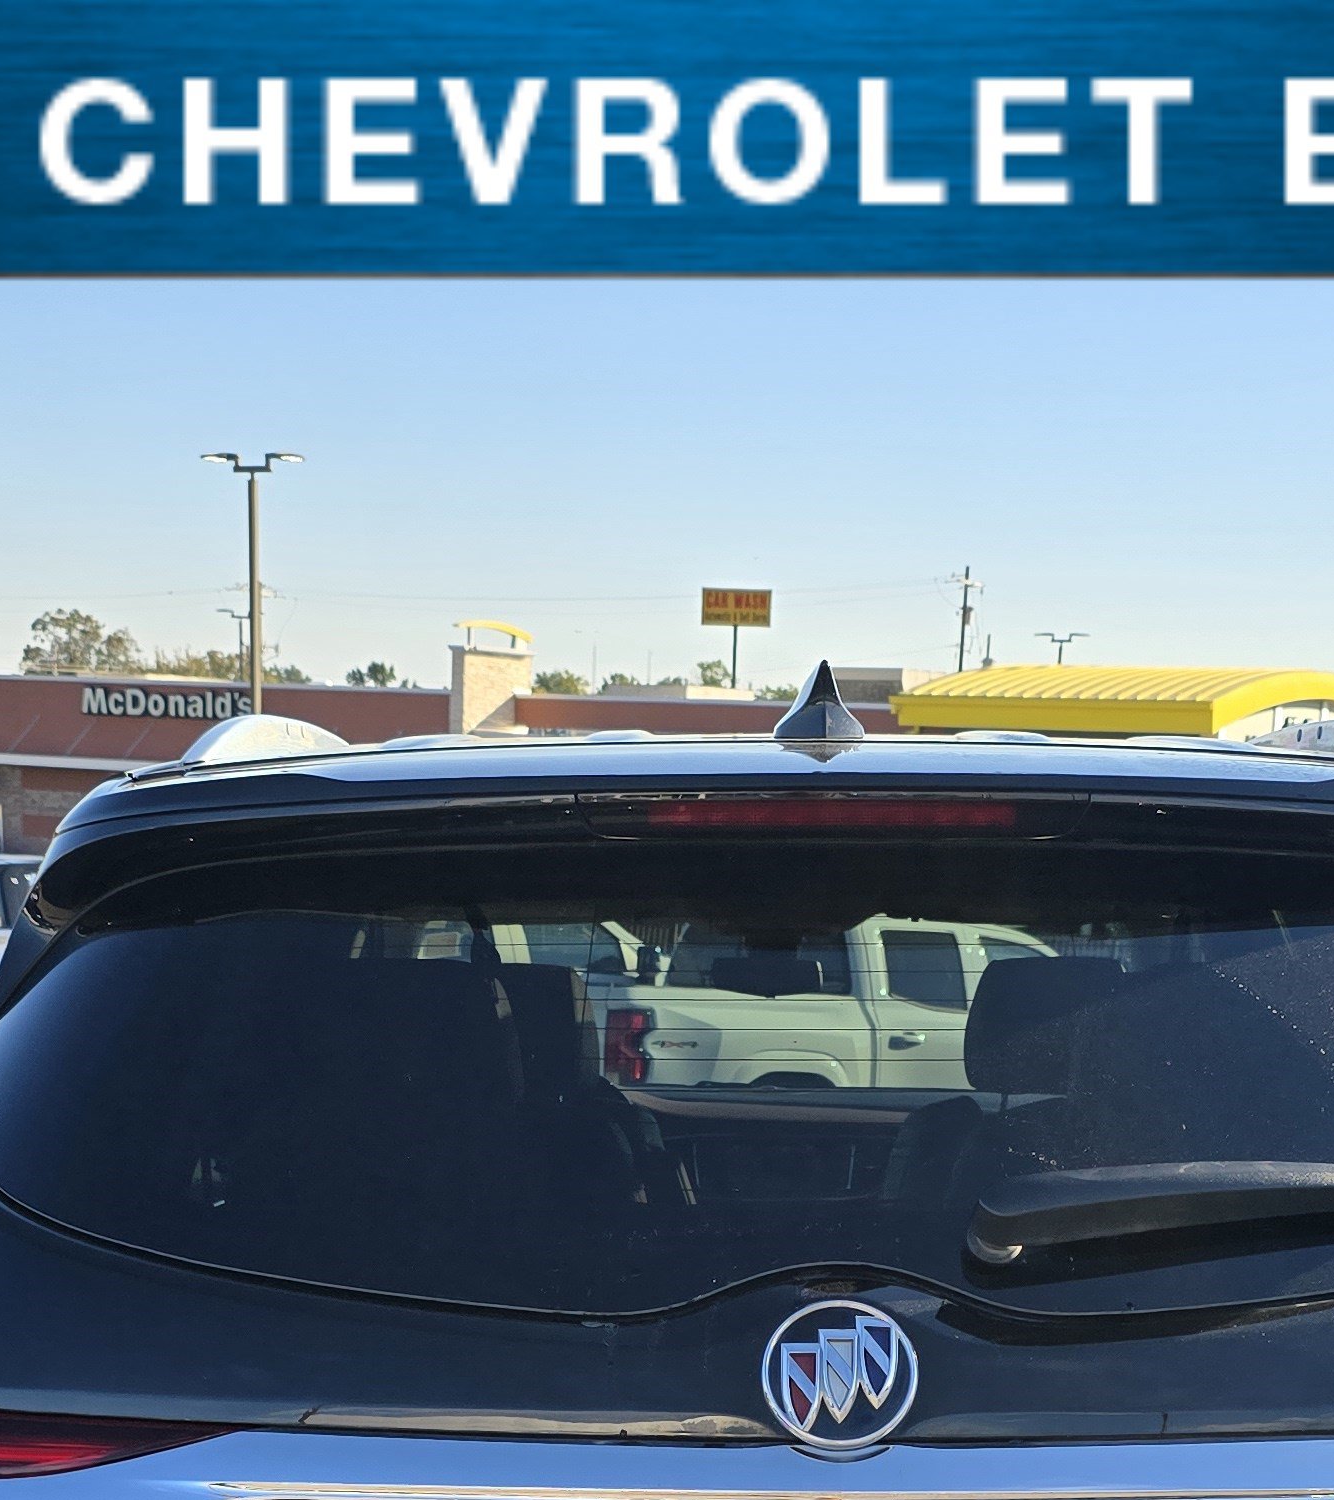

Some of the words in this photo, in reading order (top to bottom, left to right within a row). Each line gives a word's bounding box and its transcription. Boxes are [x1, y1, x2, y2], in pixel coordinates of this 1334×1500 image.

[705, 591, 729, 609] CAR
[734, 592, 767, 610] WASH
[81, 687, 252, 719] McDonald's
